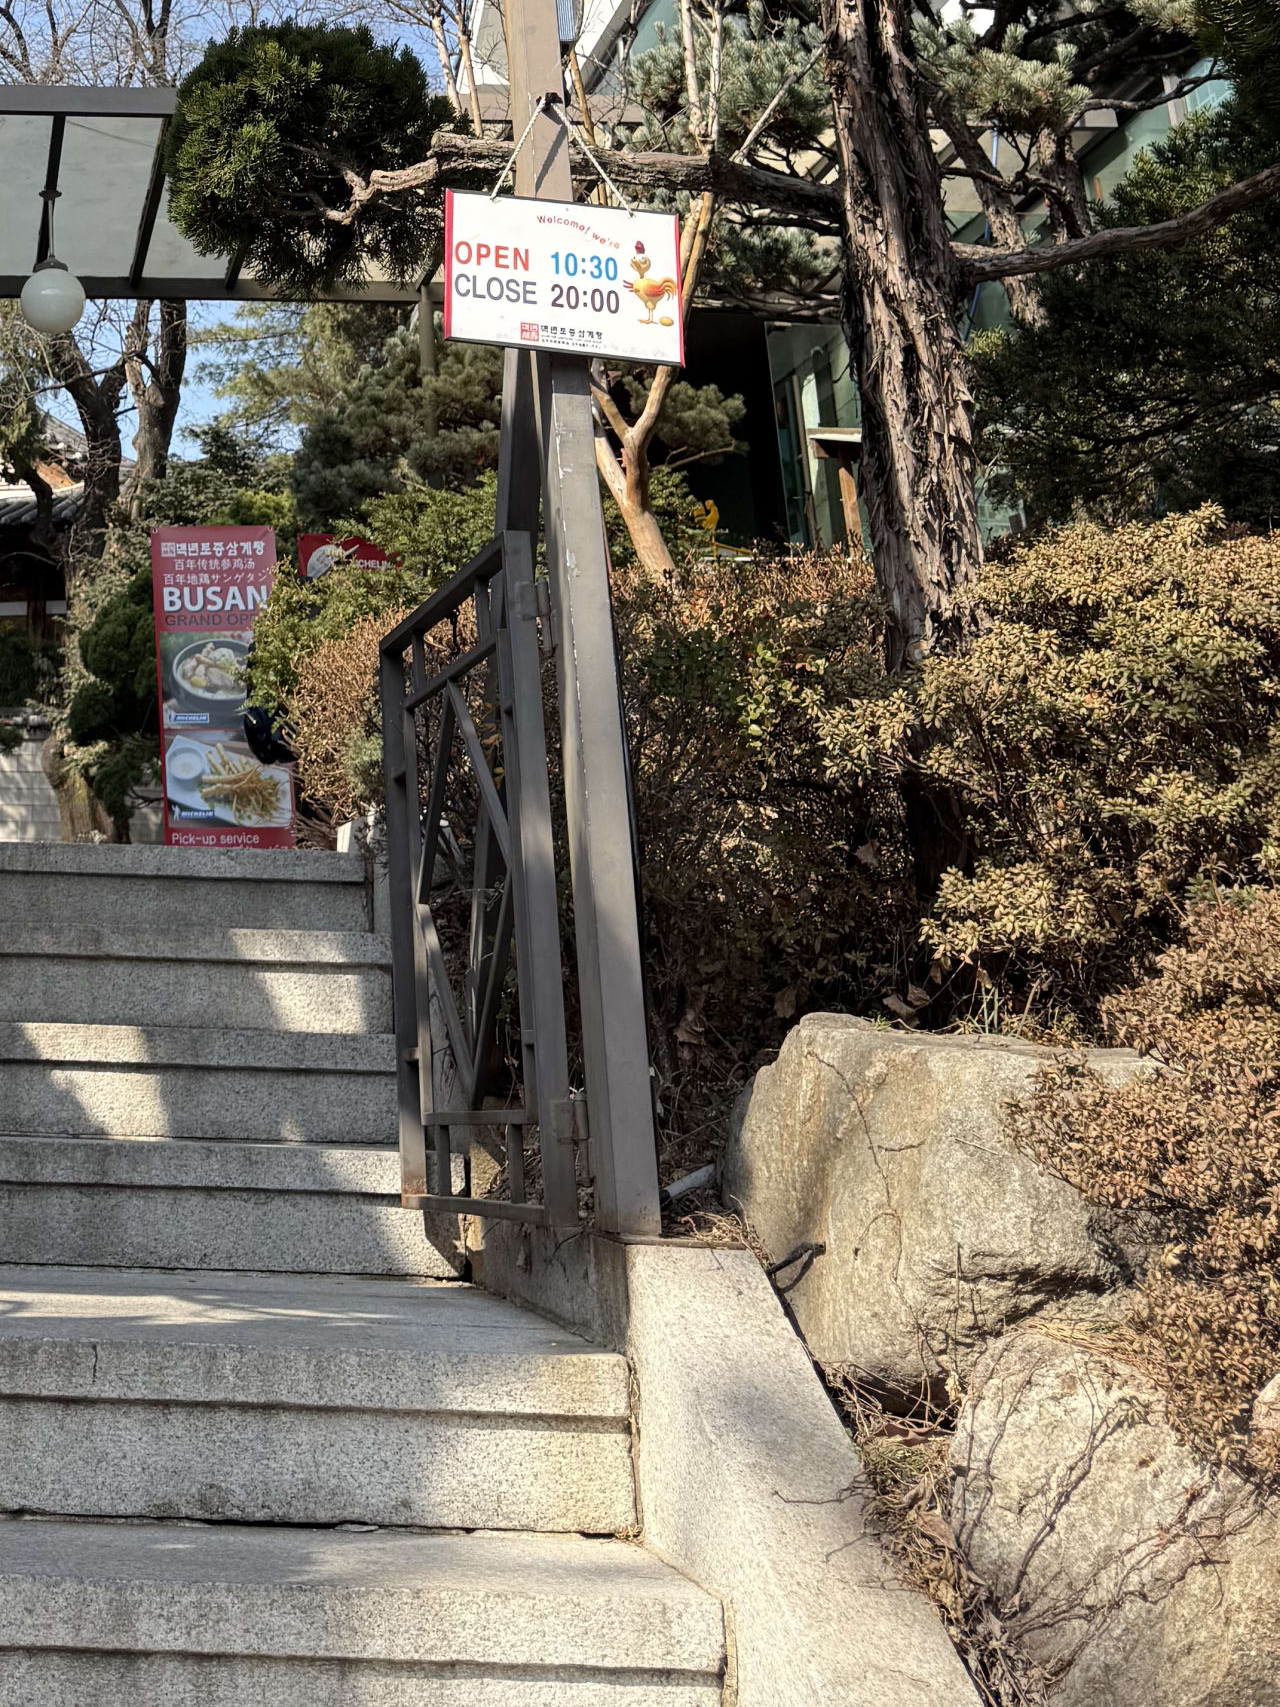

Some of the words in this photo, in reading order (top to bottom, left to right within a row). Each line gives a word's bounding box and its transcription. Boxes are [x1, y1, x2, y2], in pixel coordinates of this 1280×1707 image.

[536, 214, 591, 235] Welcome!
[454, 240, 530, 272] OPEN
[550, 251, 619, 282] 10:30
[454, 273, 538, 305] CLOSE
[550, 283, 620, 314] 20:00
[162, 584, 268, 612] BUSAN
[164, 614, 223, 627] GRAND
[171, 832, 217, 845] Pick-up
[220, 832, 260, 844] service
